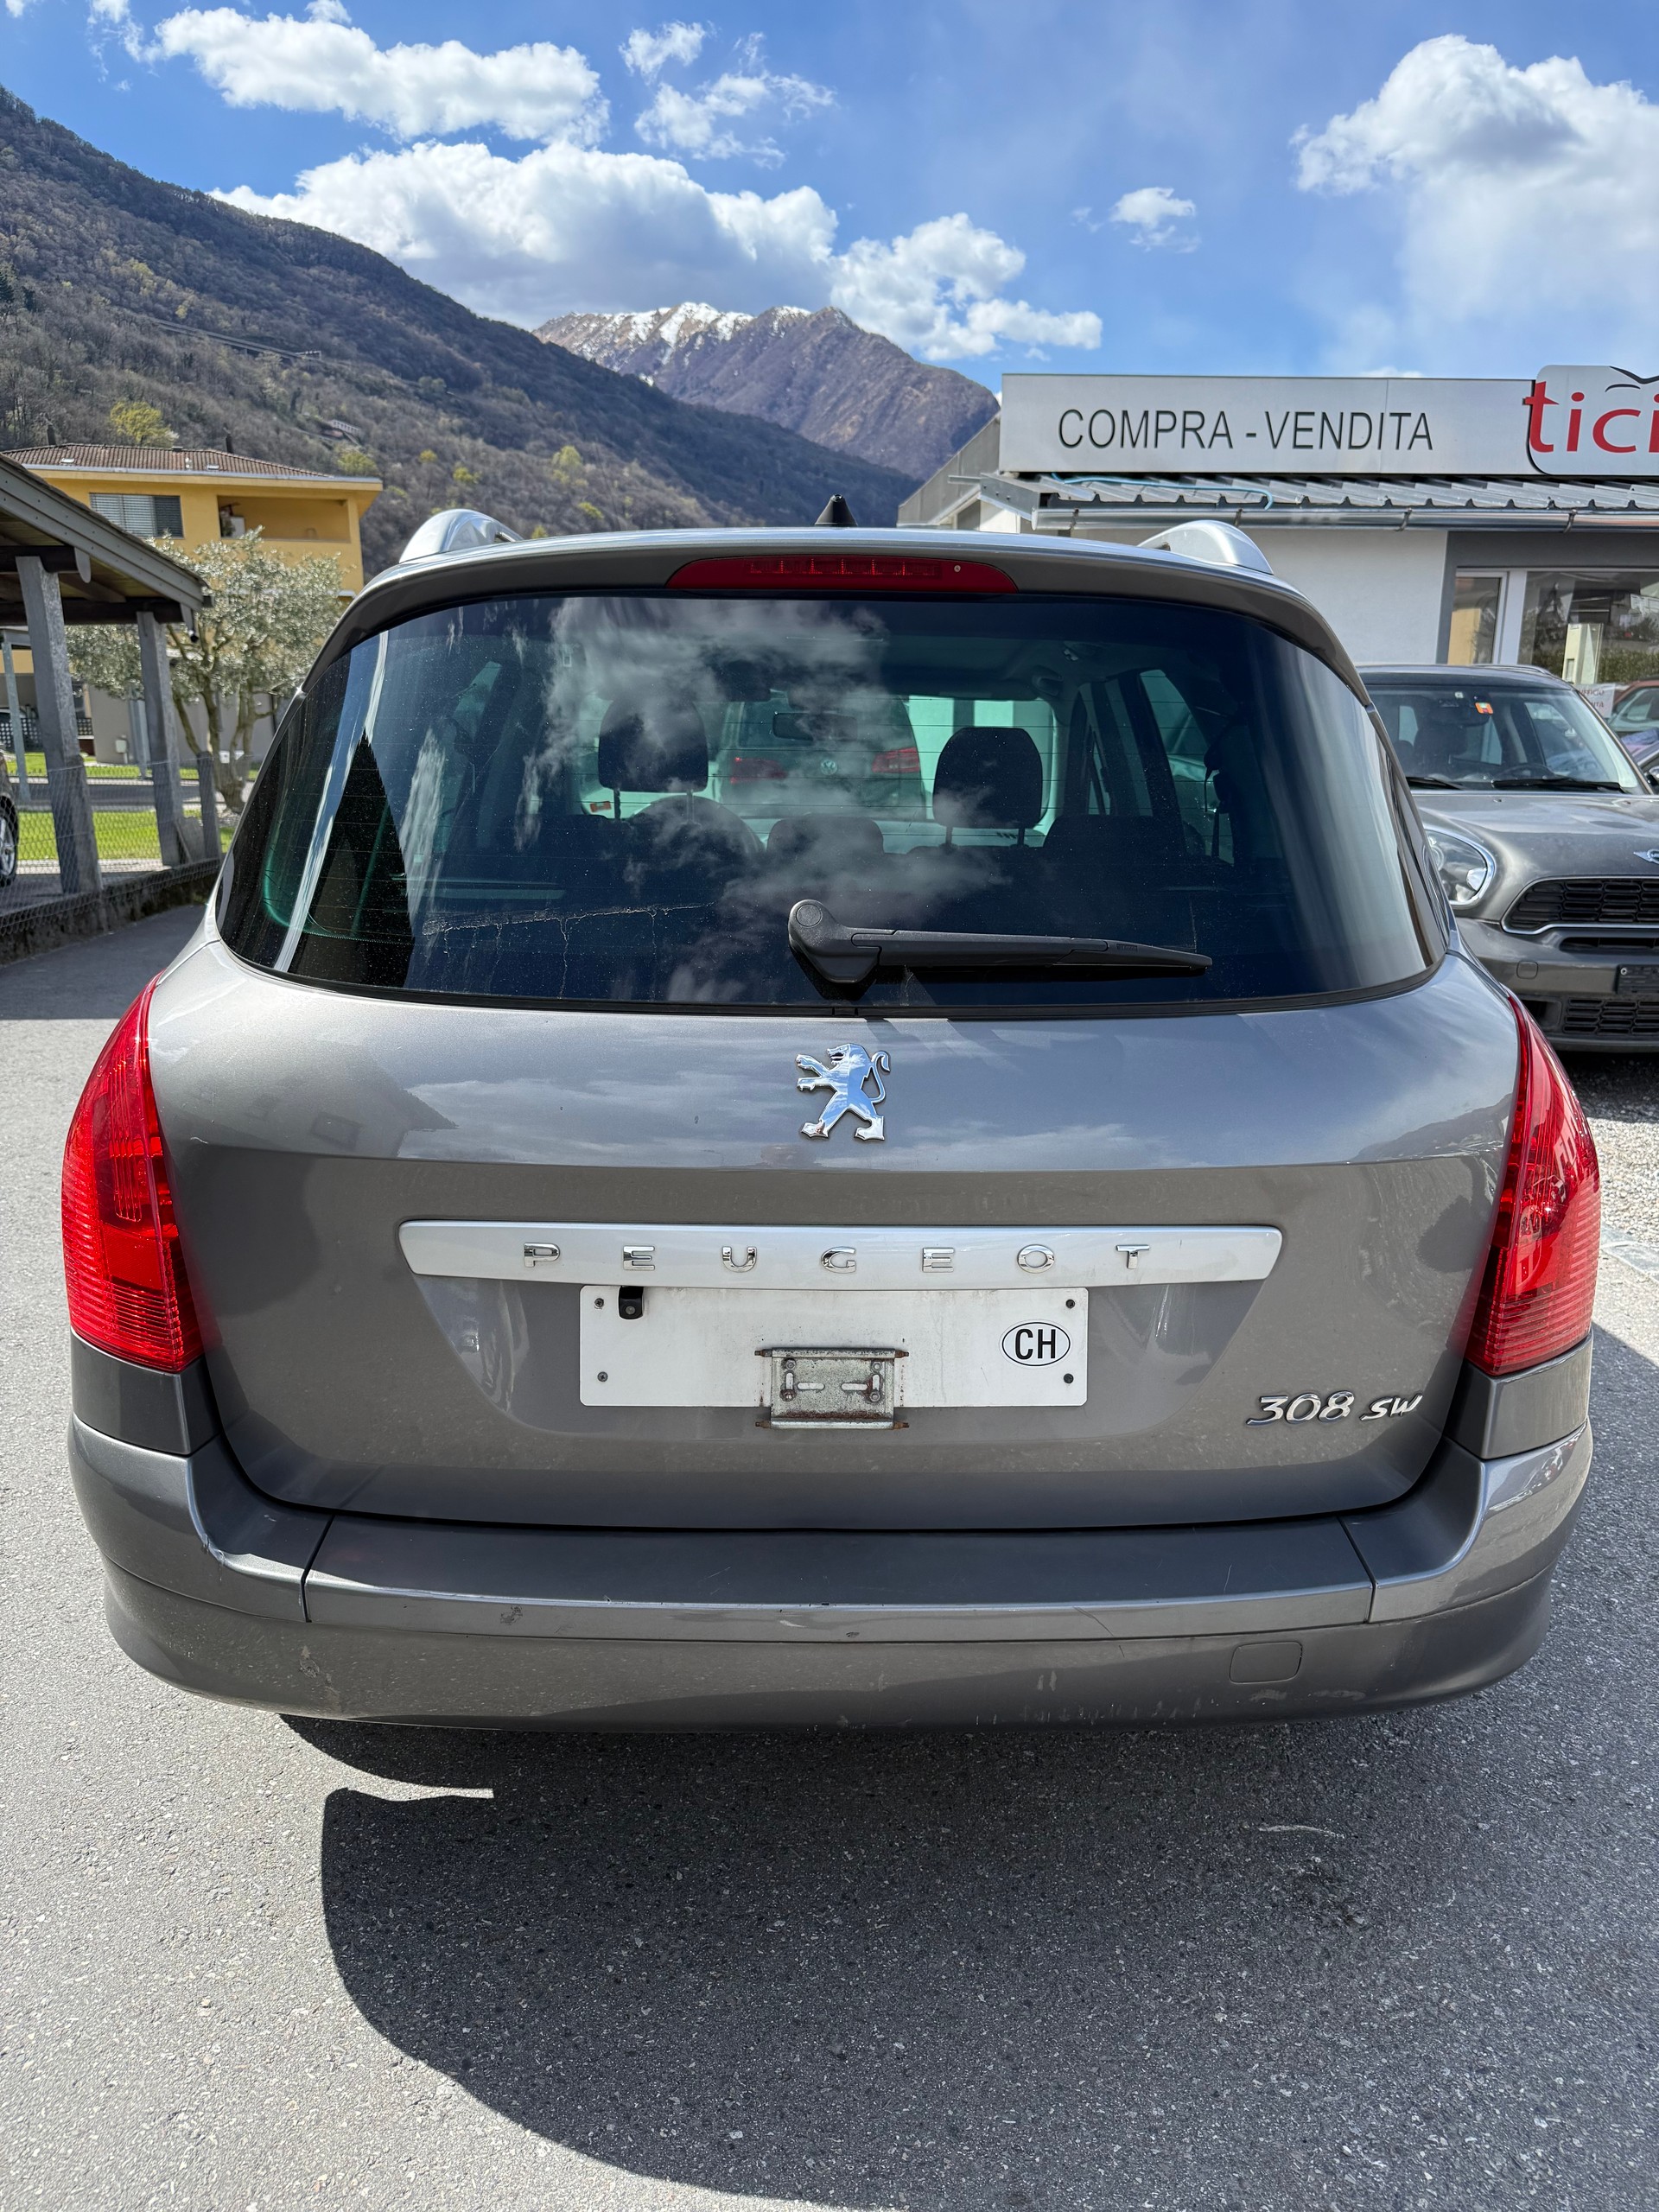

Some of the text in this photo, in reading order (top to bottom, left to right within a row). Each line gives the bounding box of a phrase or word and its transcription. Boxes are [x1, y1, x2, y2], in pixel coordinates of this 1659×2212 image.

[1058, 409, 1234, 449] COMPRA
[1264, 410, 1433, 451] VENDITA
[523, 1243, 1150, 1274] PEUGEOT
[1014, 1328, 1056, 1360] CH
[1245, 1390, 1356, 1427] 308
